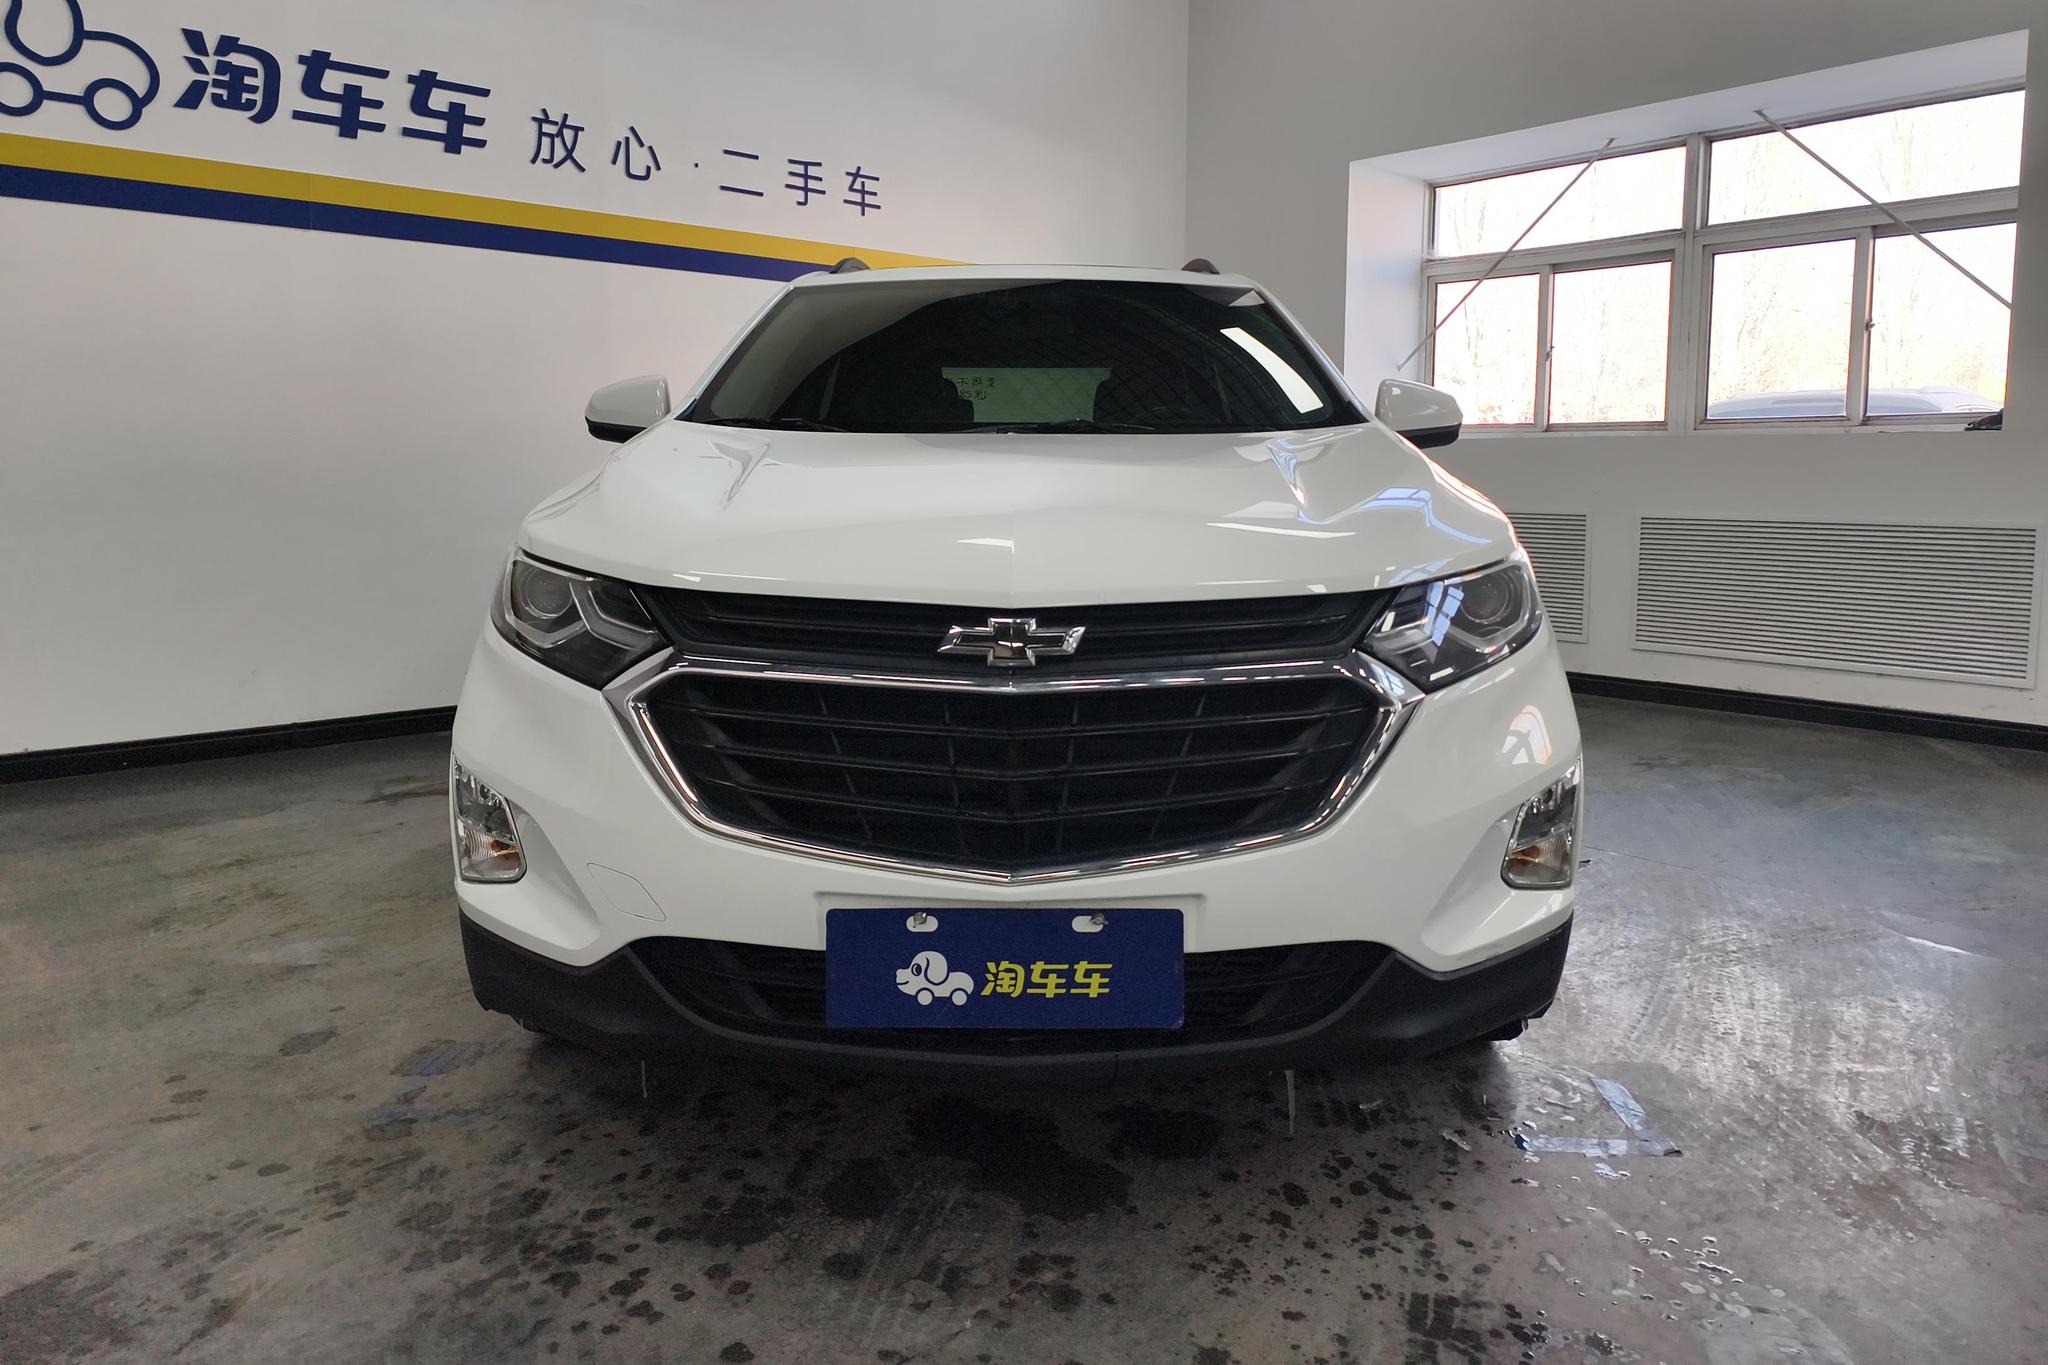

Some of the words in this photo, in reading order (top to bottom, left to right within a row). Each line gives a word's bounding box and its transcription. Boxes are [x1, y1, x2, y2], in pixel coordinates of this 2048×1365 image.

[173, 28, 491, 155] 淘车车
[981, 960, 1112, 998] 淘车车
